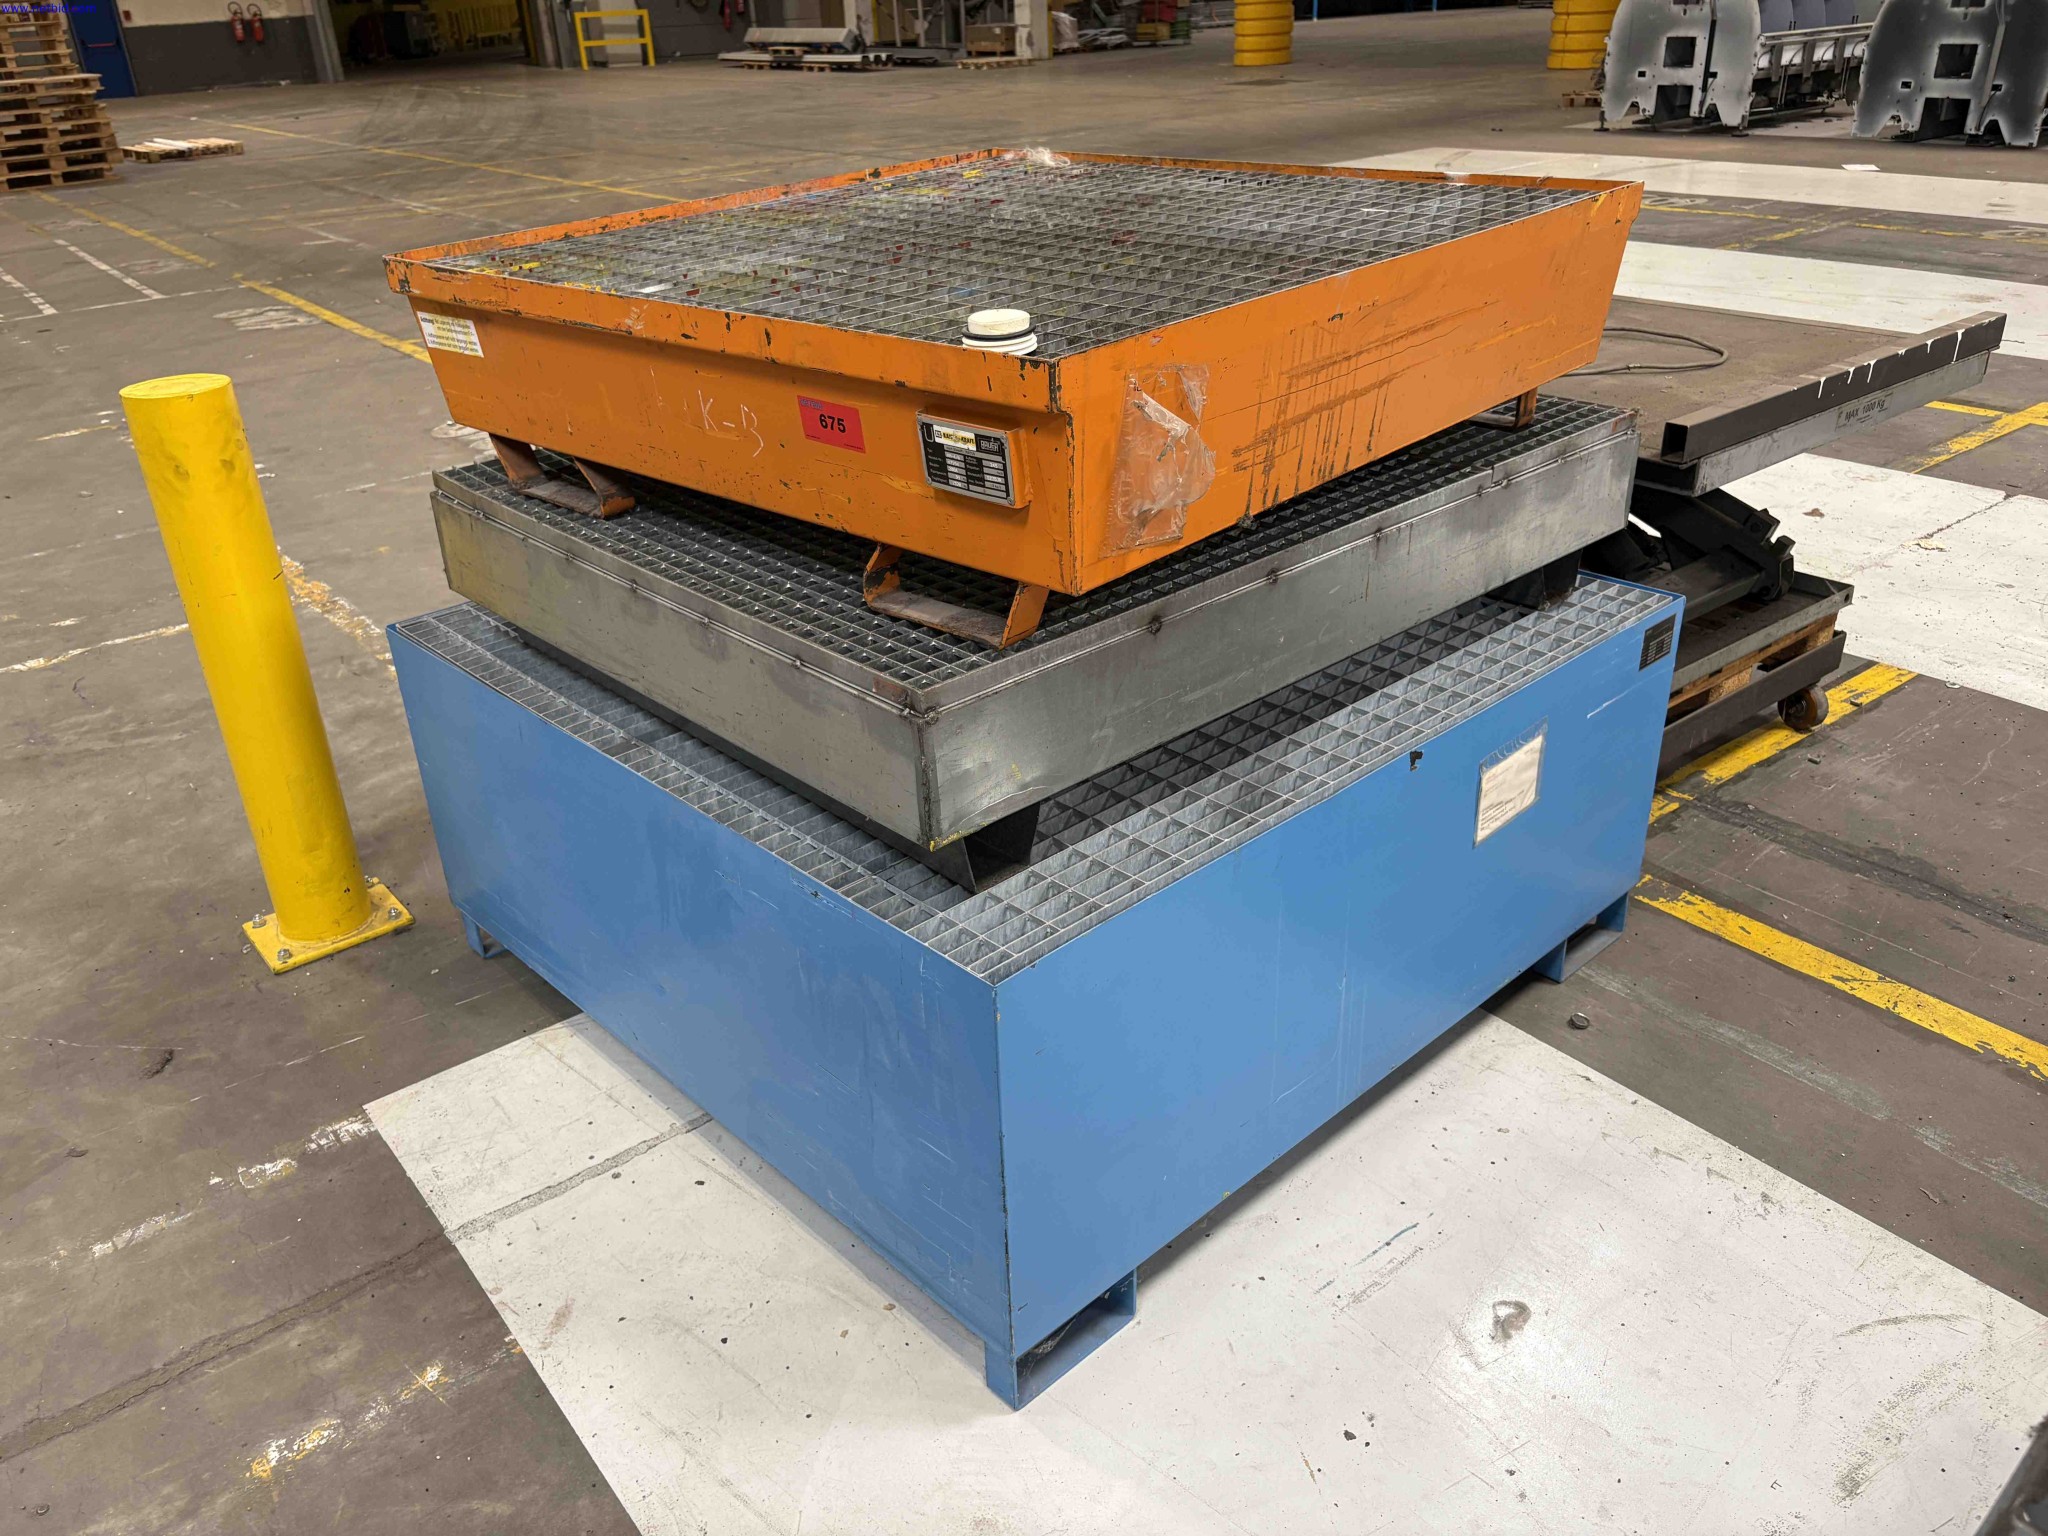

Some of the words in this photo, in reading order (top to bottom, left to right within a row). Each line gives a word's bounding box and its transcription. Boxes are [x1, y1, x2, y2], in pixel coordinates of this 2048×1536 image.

[1845, 408, 1860, 422] MAX
[1863, 401, 1876, 414] 1000
[819, 413, 846, 433] 675
